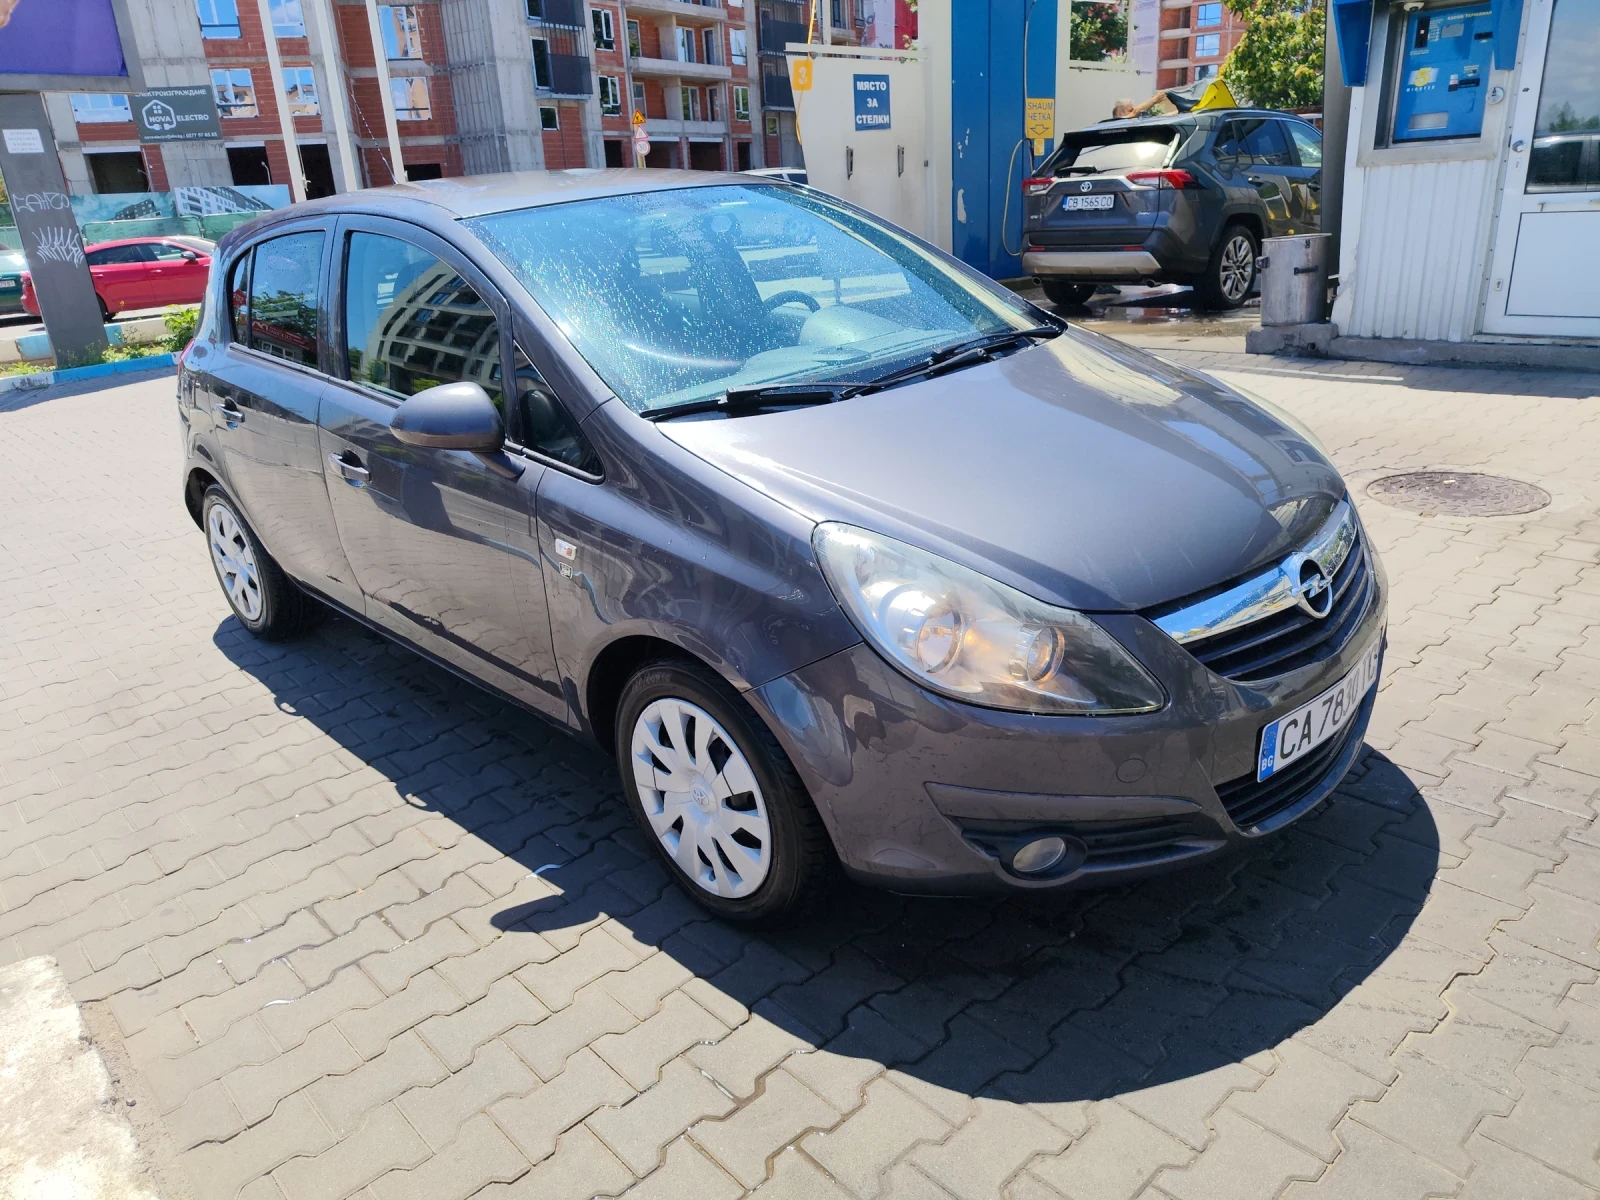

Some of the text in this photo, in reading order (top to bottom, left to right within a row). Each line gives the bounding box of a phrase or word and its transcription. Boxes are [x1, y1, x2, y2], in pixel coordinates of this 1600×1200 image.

[1413, 67, 1432, 87] 5
[856, 81, 887, 91] МЯСТО
[866, 98, 879, 108] ЗА
[1027, 102, 1053, 110] SHAUM
[149, 114, 209, 123] NOVA ELECTRO
[856, 114, 890, 125] СТЕЛКИ
[1028, 112, 1052, 121] ЧЕТКА
[1068, 197, 1078, 208] CB
[1081, 196, 1100, 208] 1565
[1280, 710, 1312, 760] CA
[1261, 755, 1274, 770] BG
